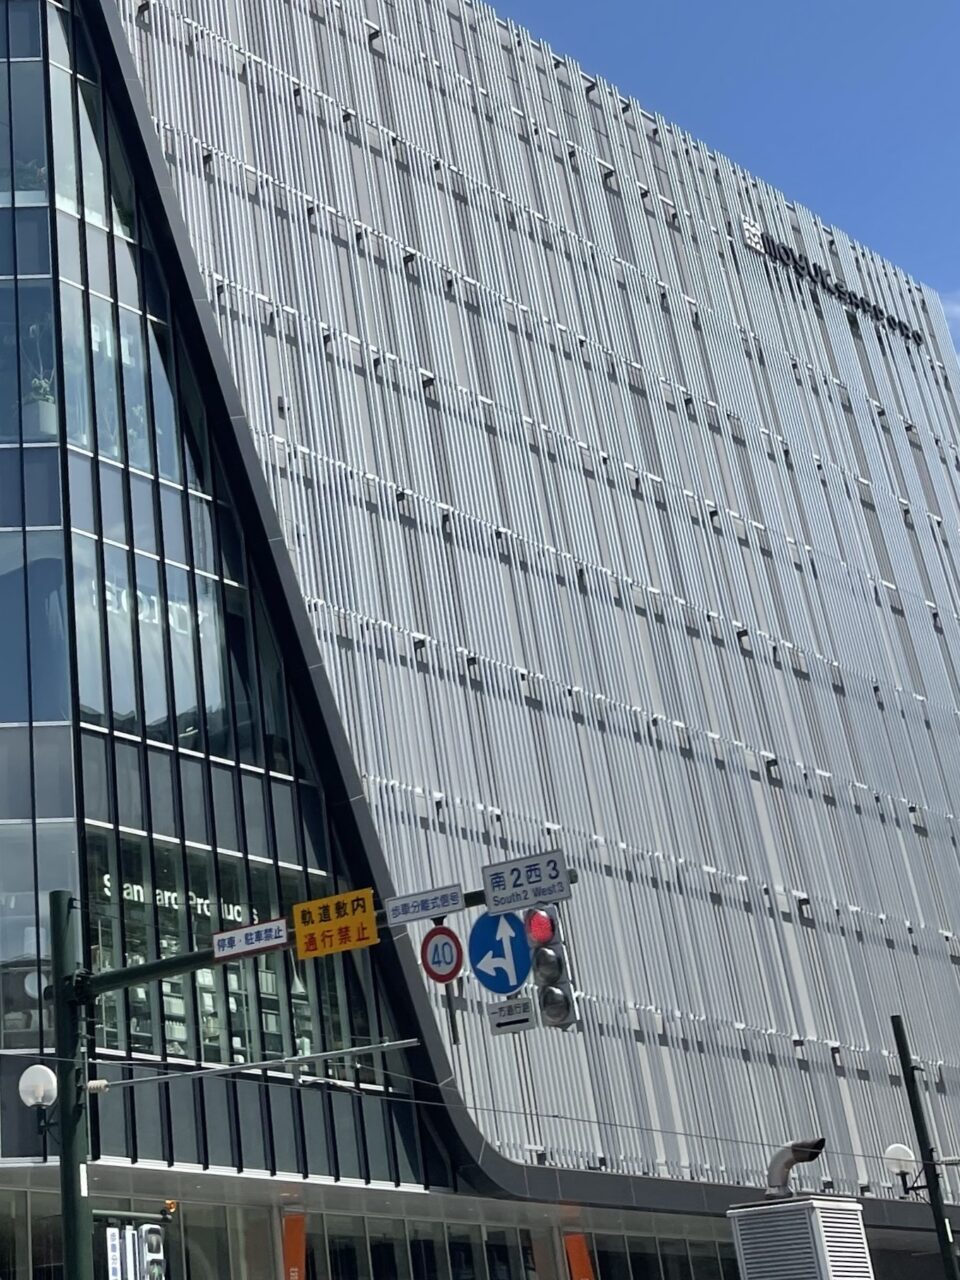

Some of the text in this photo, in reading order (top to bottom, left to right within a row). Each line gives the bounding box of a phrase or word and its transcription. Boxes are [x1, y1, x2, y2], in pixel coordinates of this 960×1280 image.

[490, 859, 560, 891] 南2西3
[301, 896, 367, 927] 軌道敷内
[304, 922, 370, 953] 通行禁止
[431, 942, 454, 967] 40
